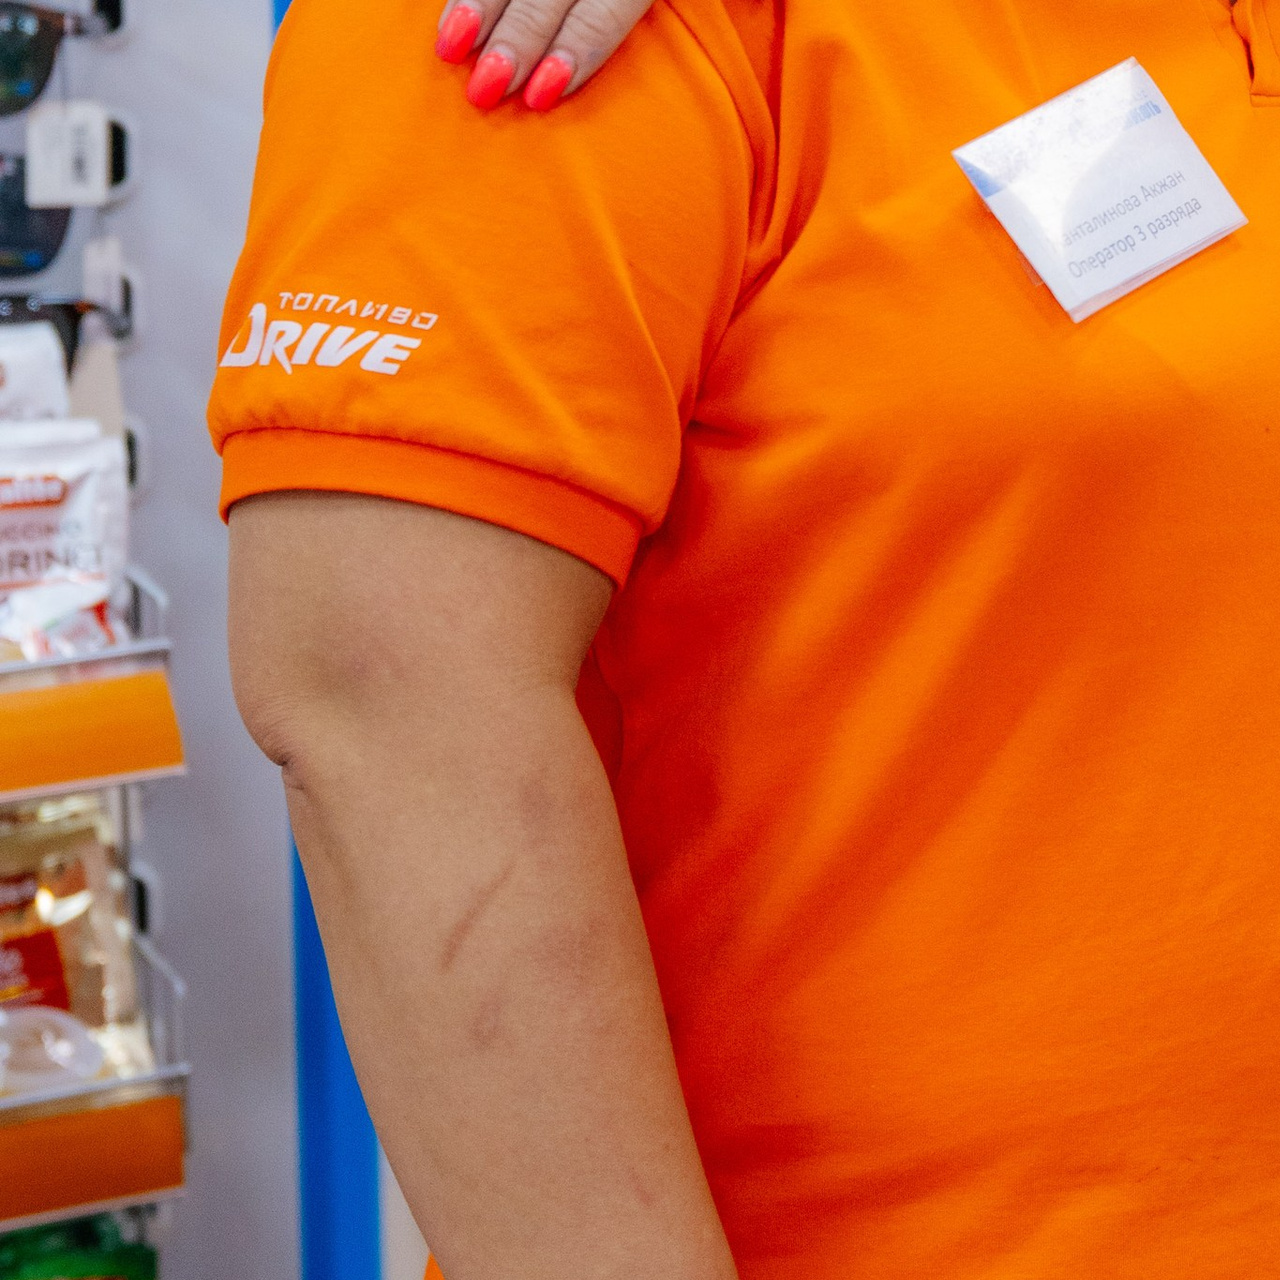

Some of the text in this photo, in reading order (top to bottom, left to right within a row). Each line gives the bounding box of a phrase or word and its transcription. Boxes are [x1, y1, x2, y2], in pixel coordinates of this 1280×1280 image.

[1054, 170, 1186, 250] анталинова Акжан
[1067, 196, 1203, 279] Оператор 3 разряда
[279, 291, 439, 330] ТОПЛИВО
